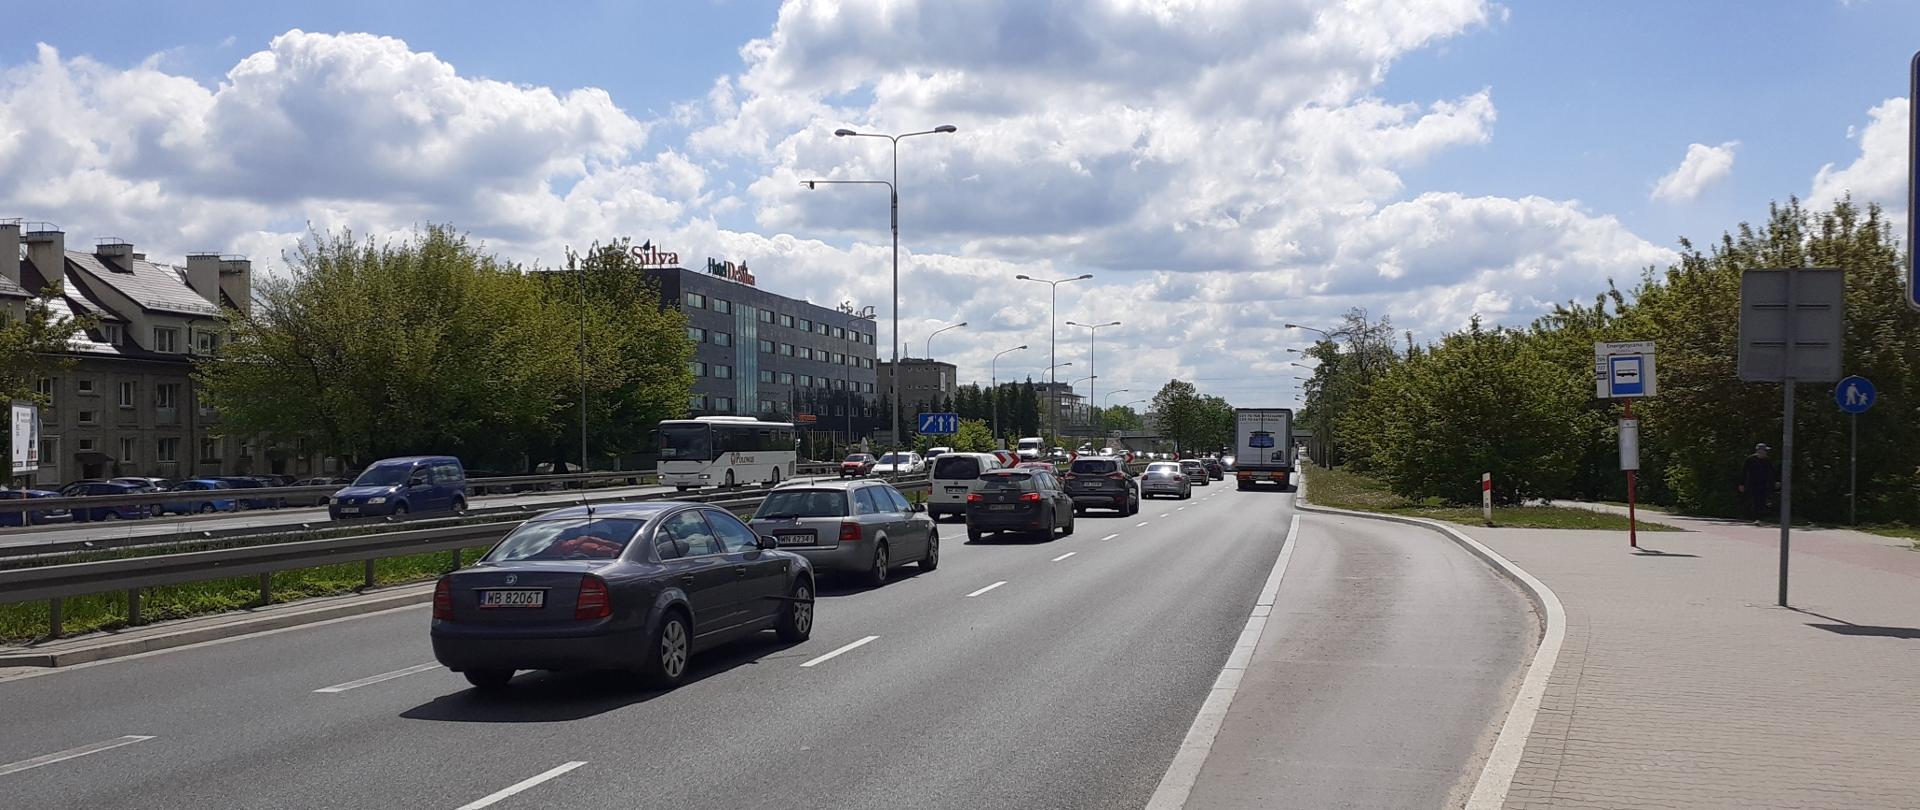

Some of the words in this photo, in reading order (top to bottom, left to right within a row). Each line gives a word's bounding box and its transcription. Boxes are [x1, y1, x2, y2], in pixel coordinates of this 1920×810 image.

[631, 241, 679, 265] Silva
[1606, 342, 1643, 350] Energetyczna
[487, 592, 502, 604] WB
[505, 592, 541, 604] 8206T
